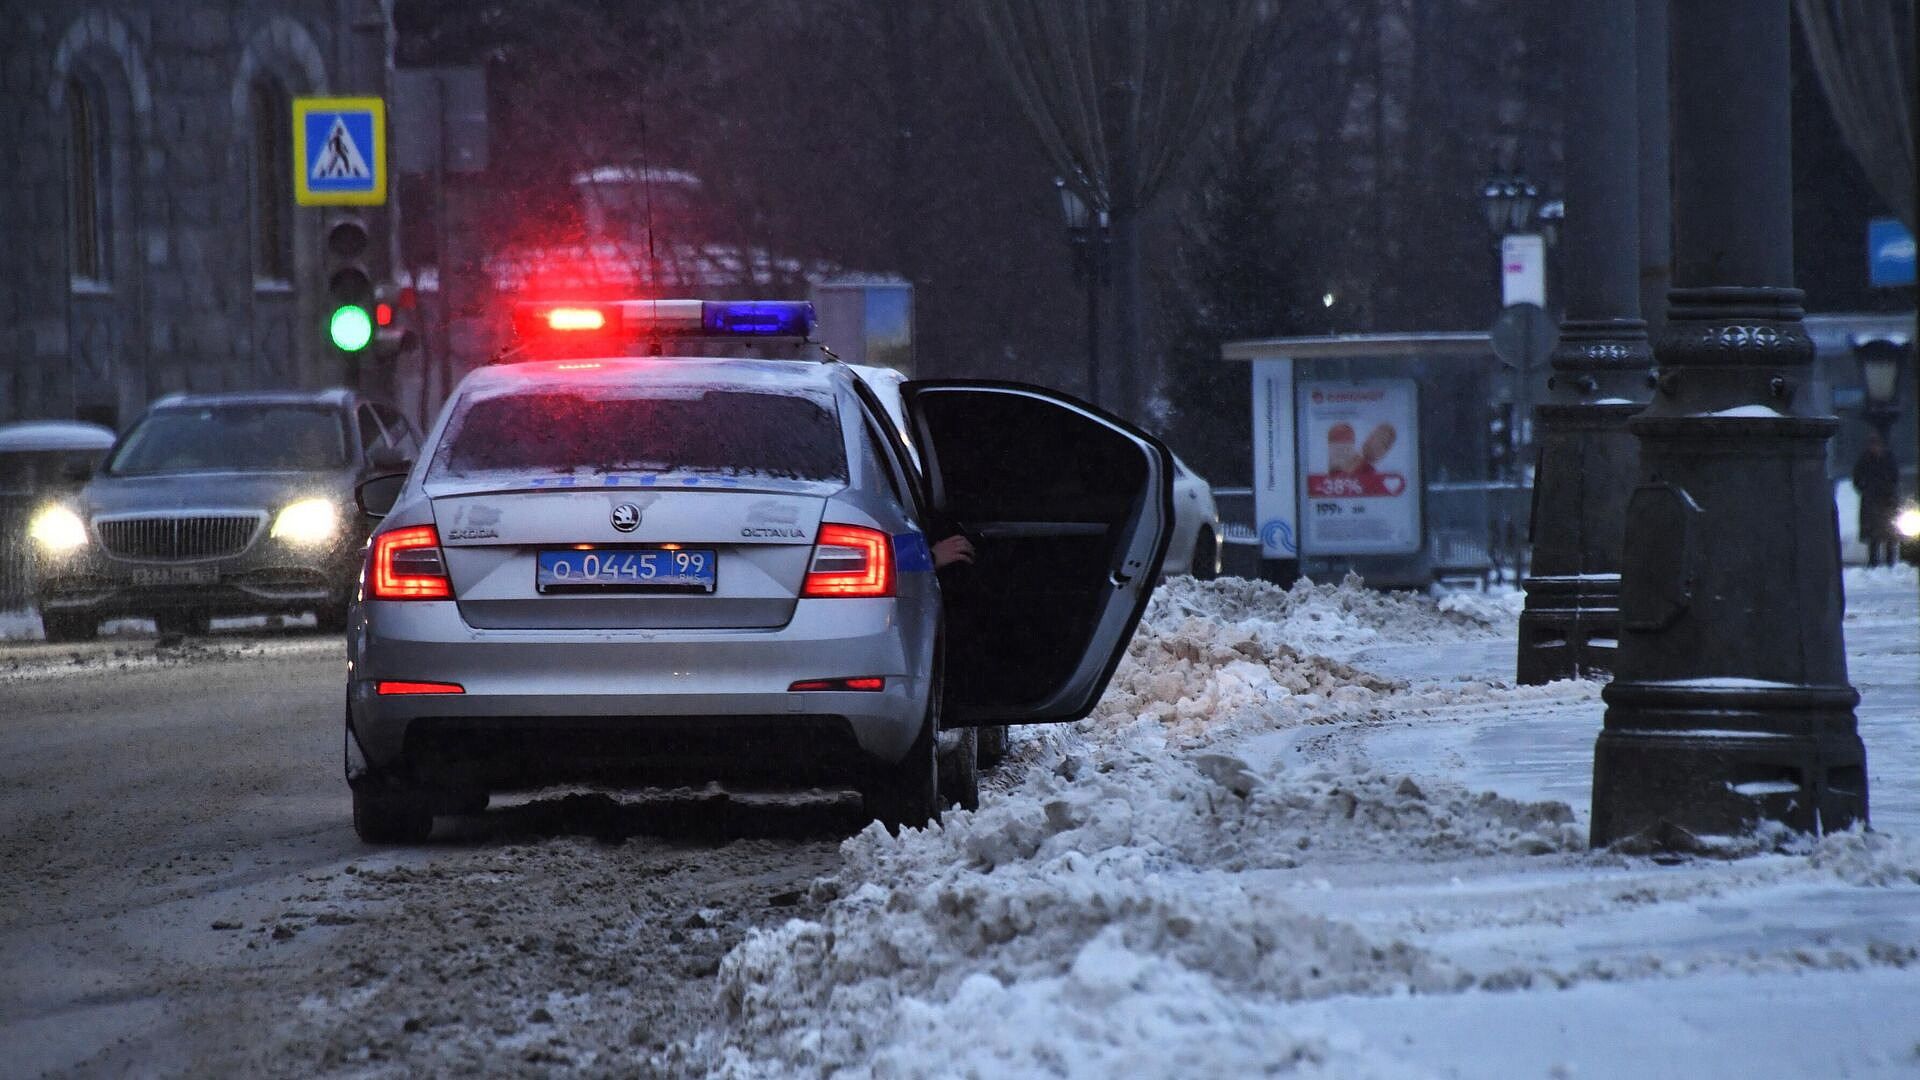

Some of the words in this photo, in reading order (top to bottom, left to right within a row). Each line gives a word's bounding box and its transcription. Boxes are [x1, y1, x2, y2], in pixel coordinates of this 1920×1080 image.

[741, 528, 806, 538] OCTAVIA
[583, 554, 657, 579] 0445
[676, 553, 704, 573] 99
